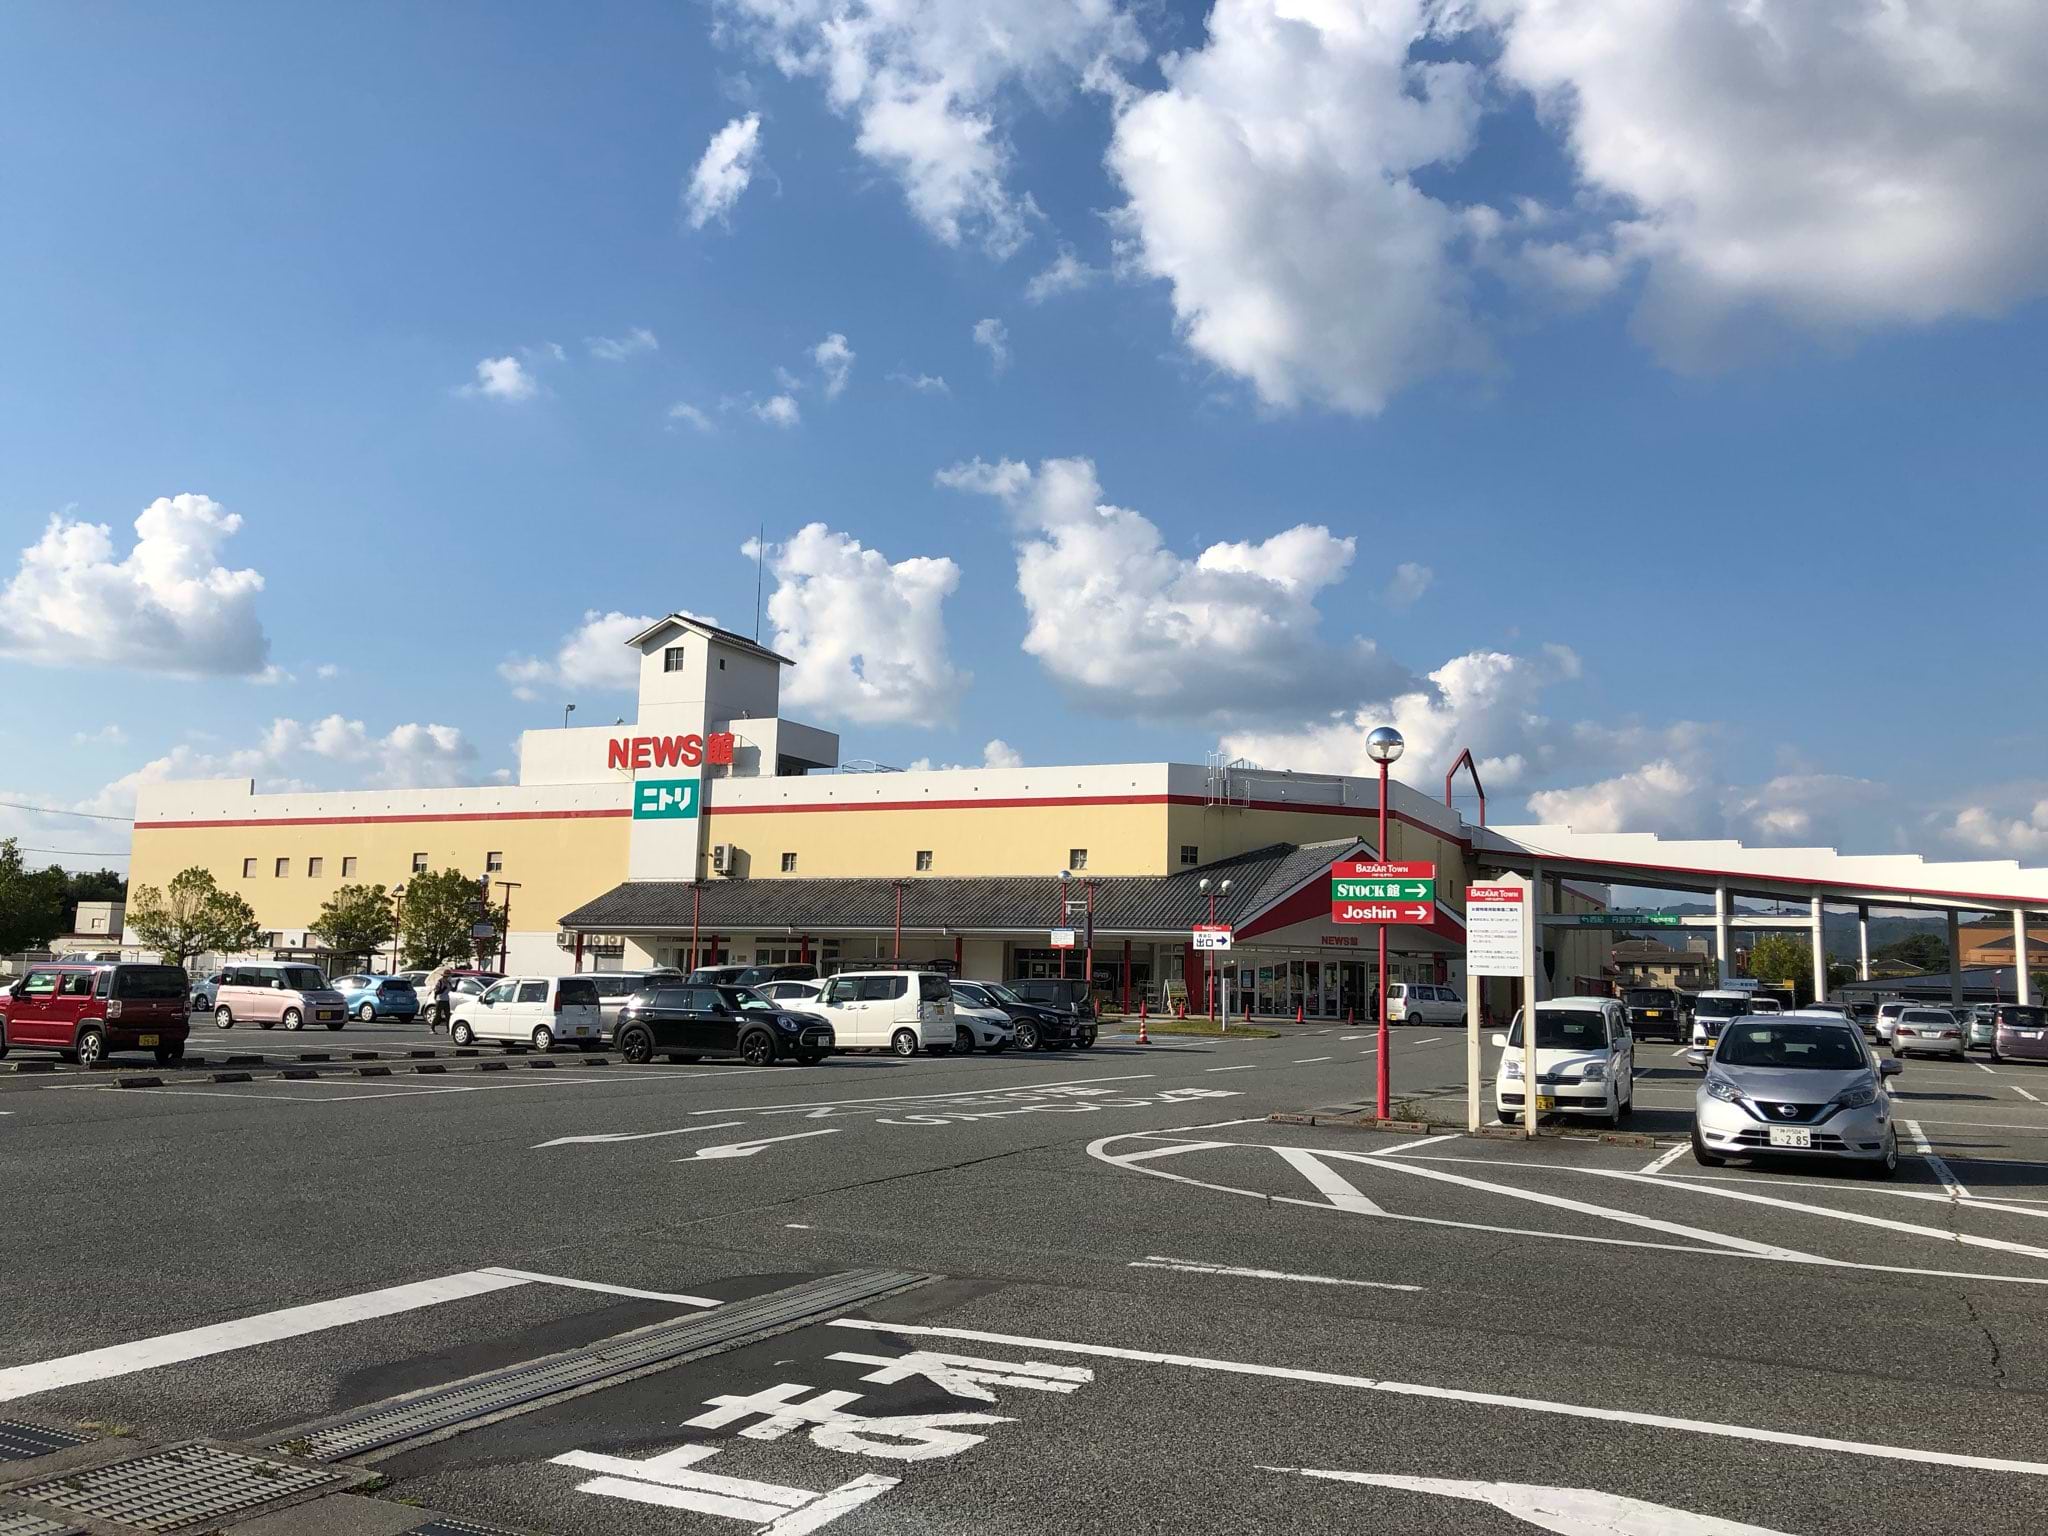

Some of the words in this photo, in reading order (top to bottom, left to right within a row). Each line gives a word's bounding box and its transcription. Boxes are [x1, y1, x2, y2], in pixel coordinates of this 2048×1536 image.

[642, 787, 691, 811] ニトリ
[1342, 905, 1397, 919] Joshin
[1196, 938, 1213, 947] 出口
